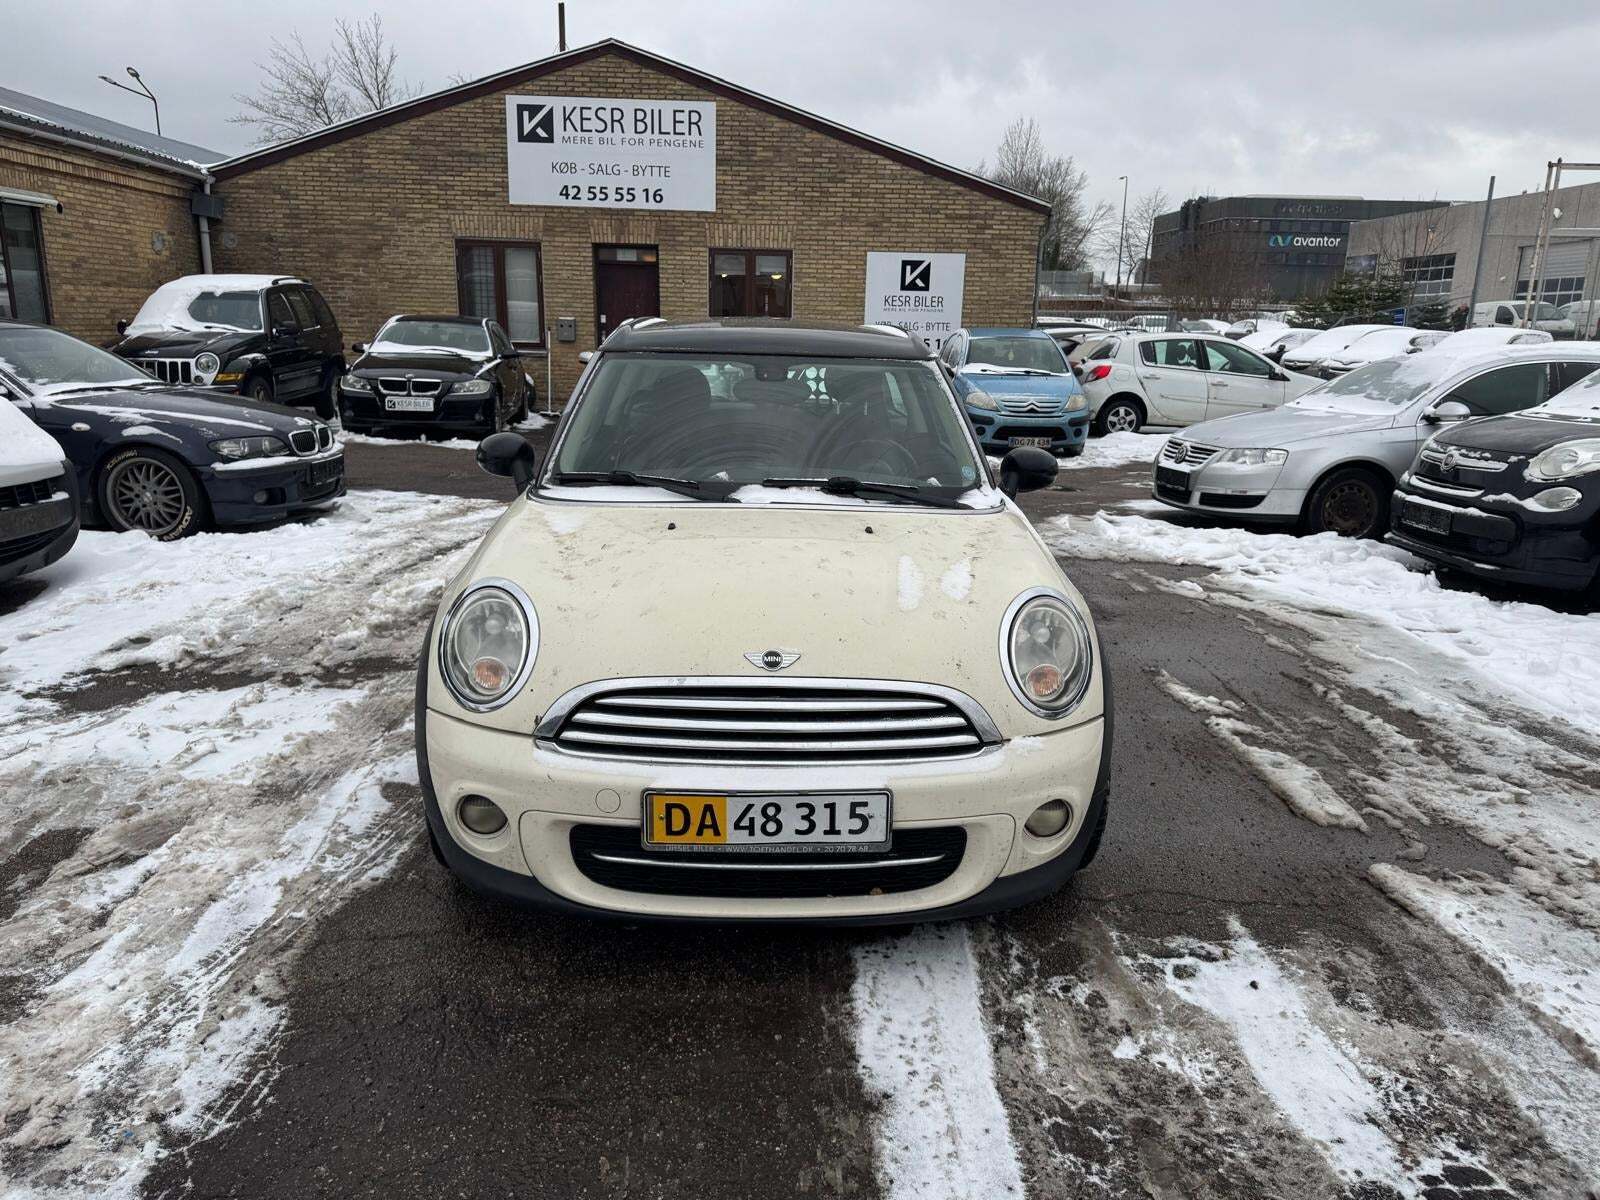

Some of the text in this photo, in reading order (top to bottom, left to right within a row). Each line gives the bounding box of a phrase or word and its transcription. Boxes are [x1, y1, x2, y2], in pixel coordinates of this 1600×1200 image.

[562, 105, 702, 137] KESR BILER
[562, 135, 705, 149] MERE BIL FOR PENGENE
[551, 161, 578, 174] KØB
[588, 163, 621, 176] SALG
[632, 164, 671, 178] BYTTE
[559, 184, 664, 204] 42 55 55 16
[1293, 235, 1341, 247] avantor
[884, 295, 944, 308] KESR BILER
[925, 321, 951, 332] BYTTE
[664, 801, 870, 837] DA 48 315
